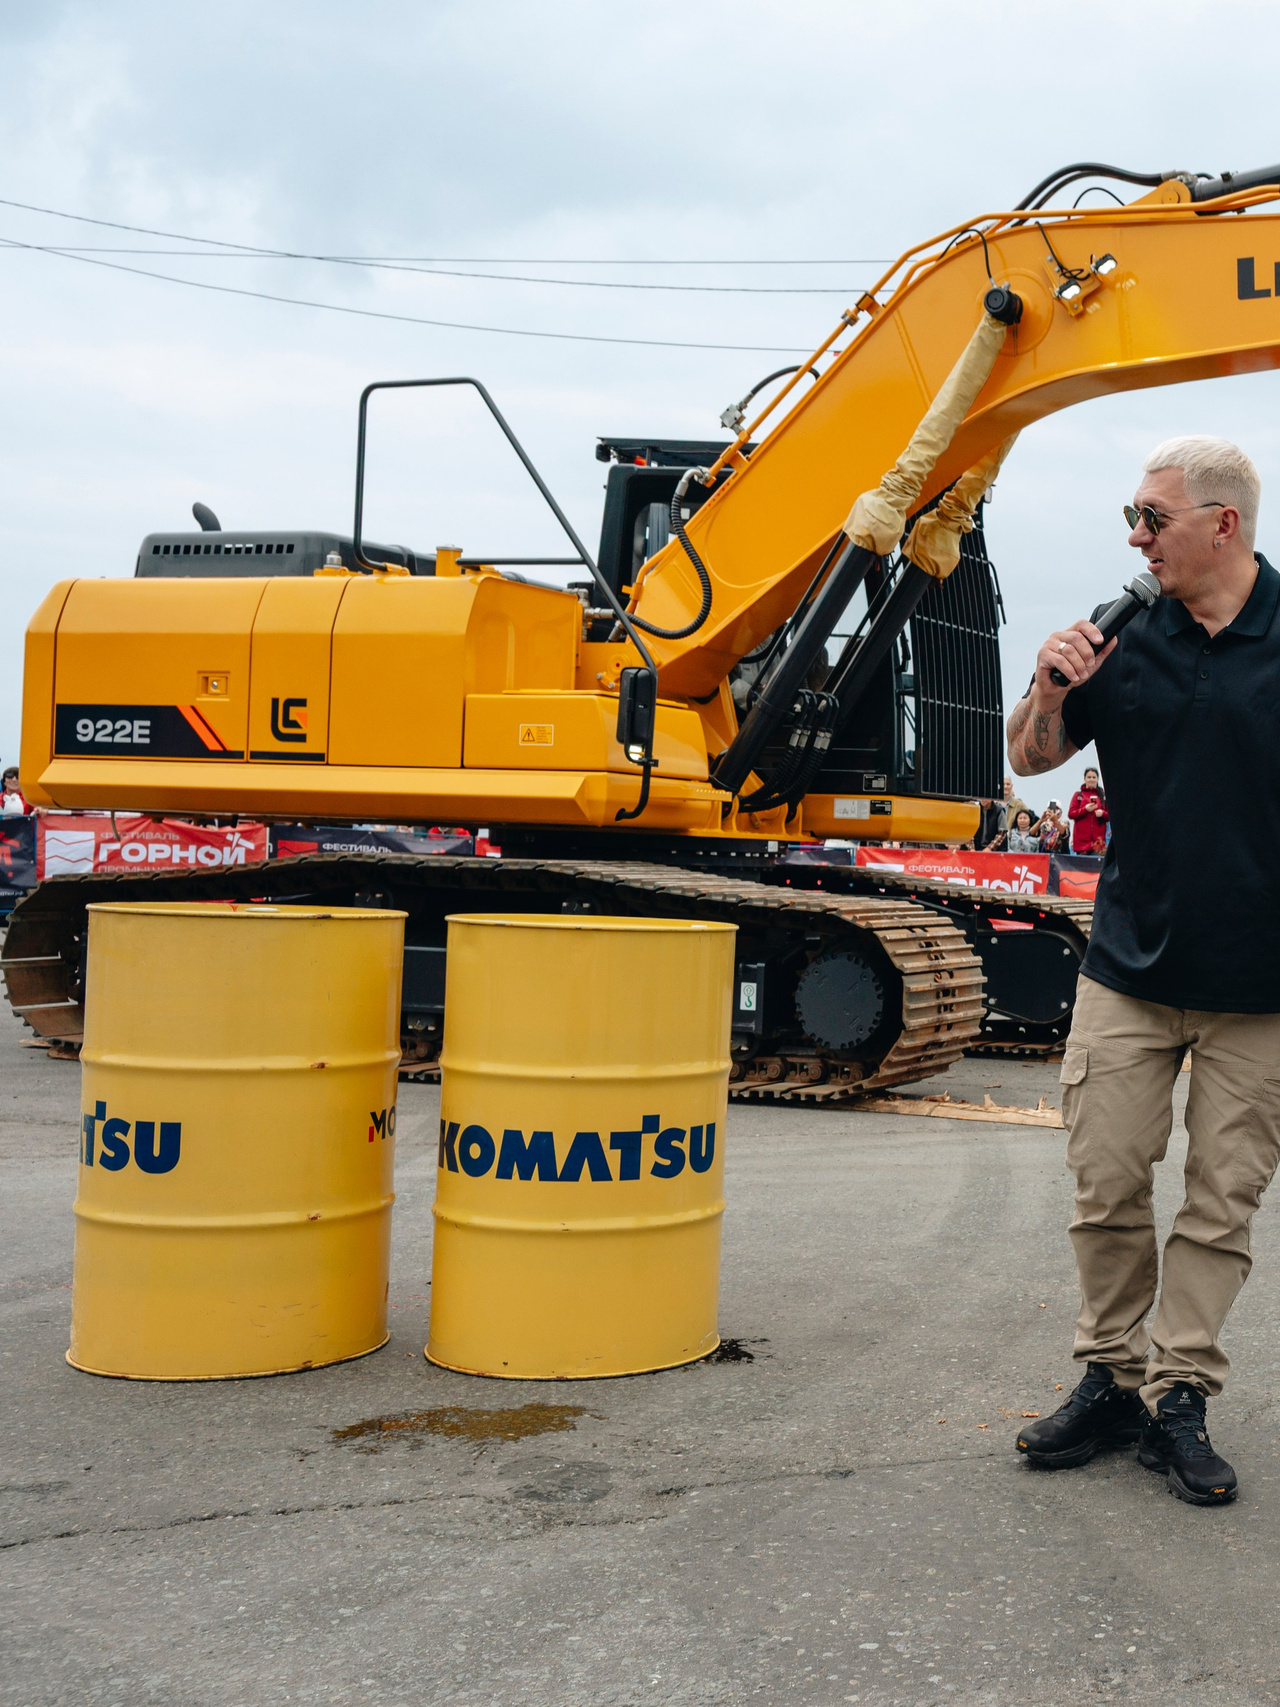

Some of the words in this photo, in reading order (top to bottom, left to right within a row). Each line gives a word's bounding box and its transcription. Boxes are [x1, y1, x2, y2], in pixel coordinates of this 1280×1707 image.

[75, 718, 151, 744] 922E
[98, 832, 255, 867] ГОРНОЙ
[322, 842, 392, 854] ФЕСТИВАЛЬ
[908, 864, 975, 875] ФЕСТИВАЛЬ
[80, 1100, 182, 1174] TSU
[438, 1114, 716, 1182] KOMATSU
